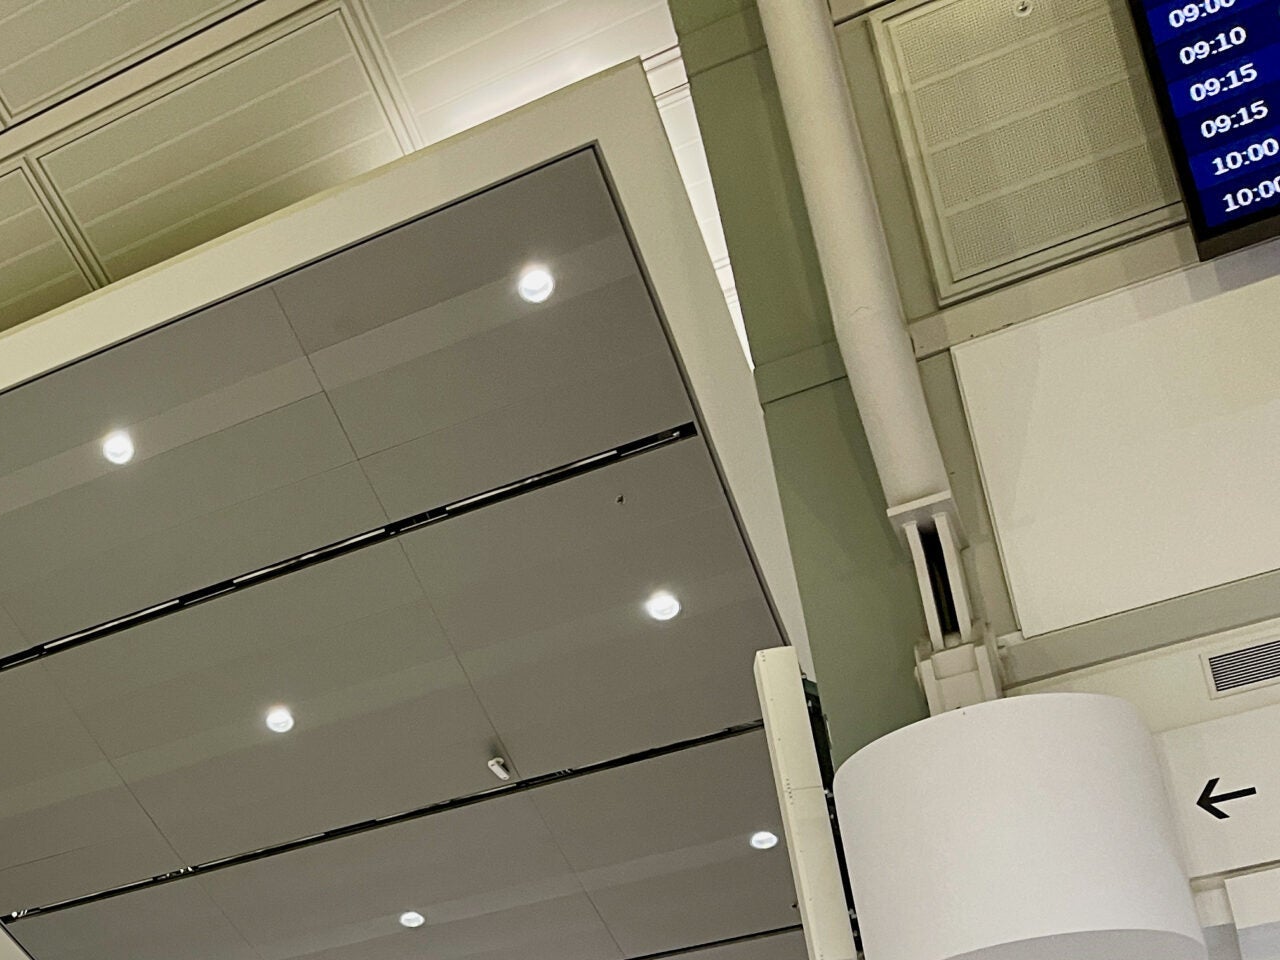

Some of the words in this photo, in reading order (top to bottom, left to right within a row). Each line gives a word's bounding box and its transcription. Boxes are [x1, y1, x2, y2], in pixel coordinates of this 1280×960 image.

[1180, 26, 1247, 65] 09:10
[1189, 62, 1258, 102] 09:15
[1200, 99, 1269, 139] 09:15
[1212, 138, 1279, 176] 10:00
